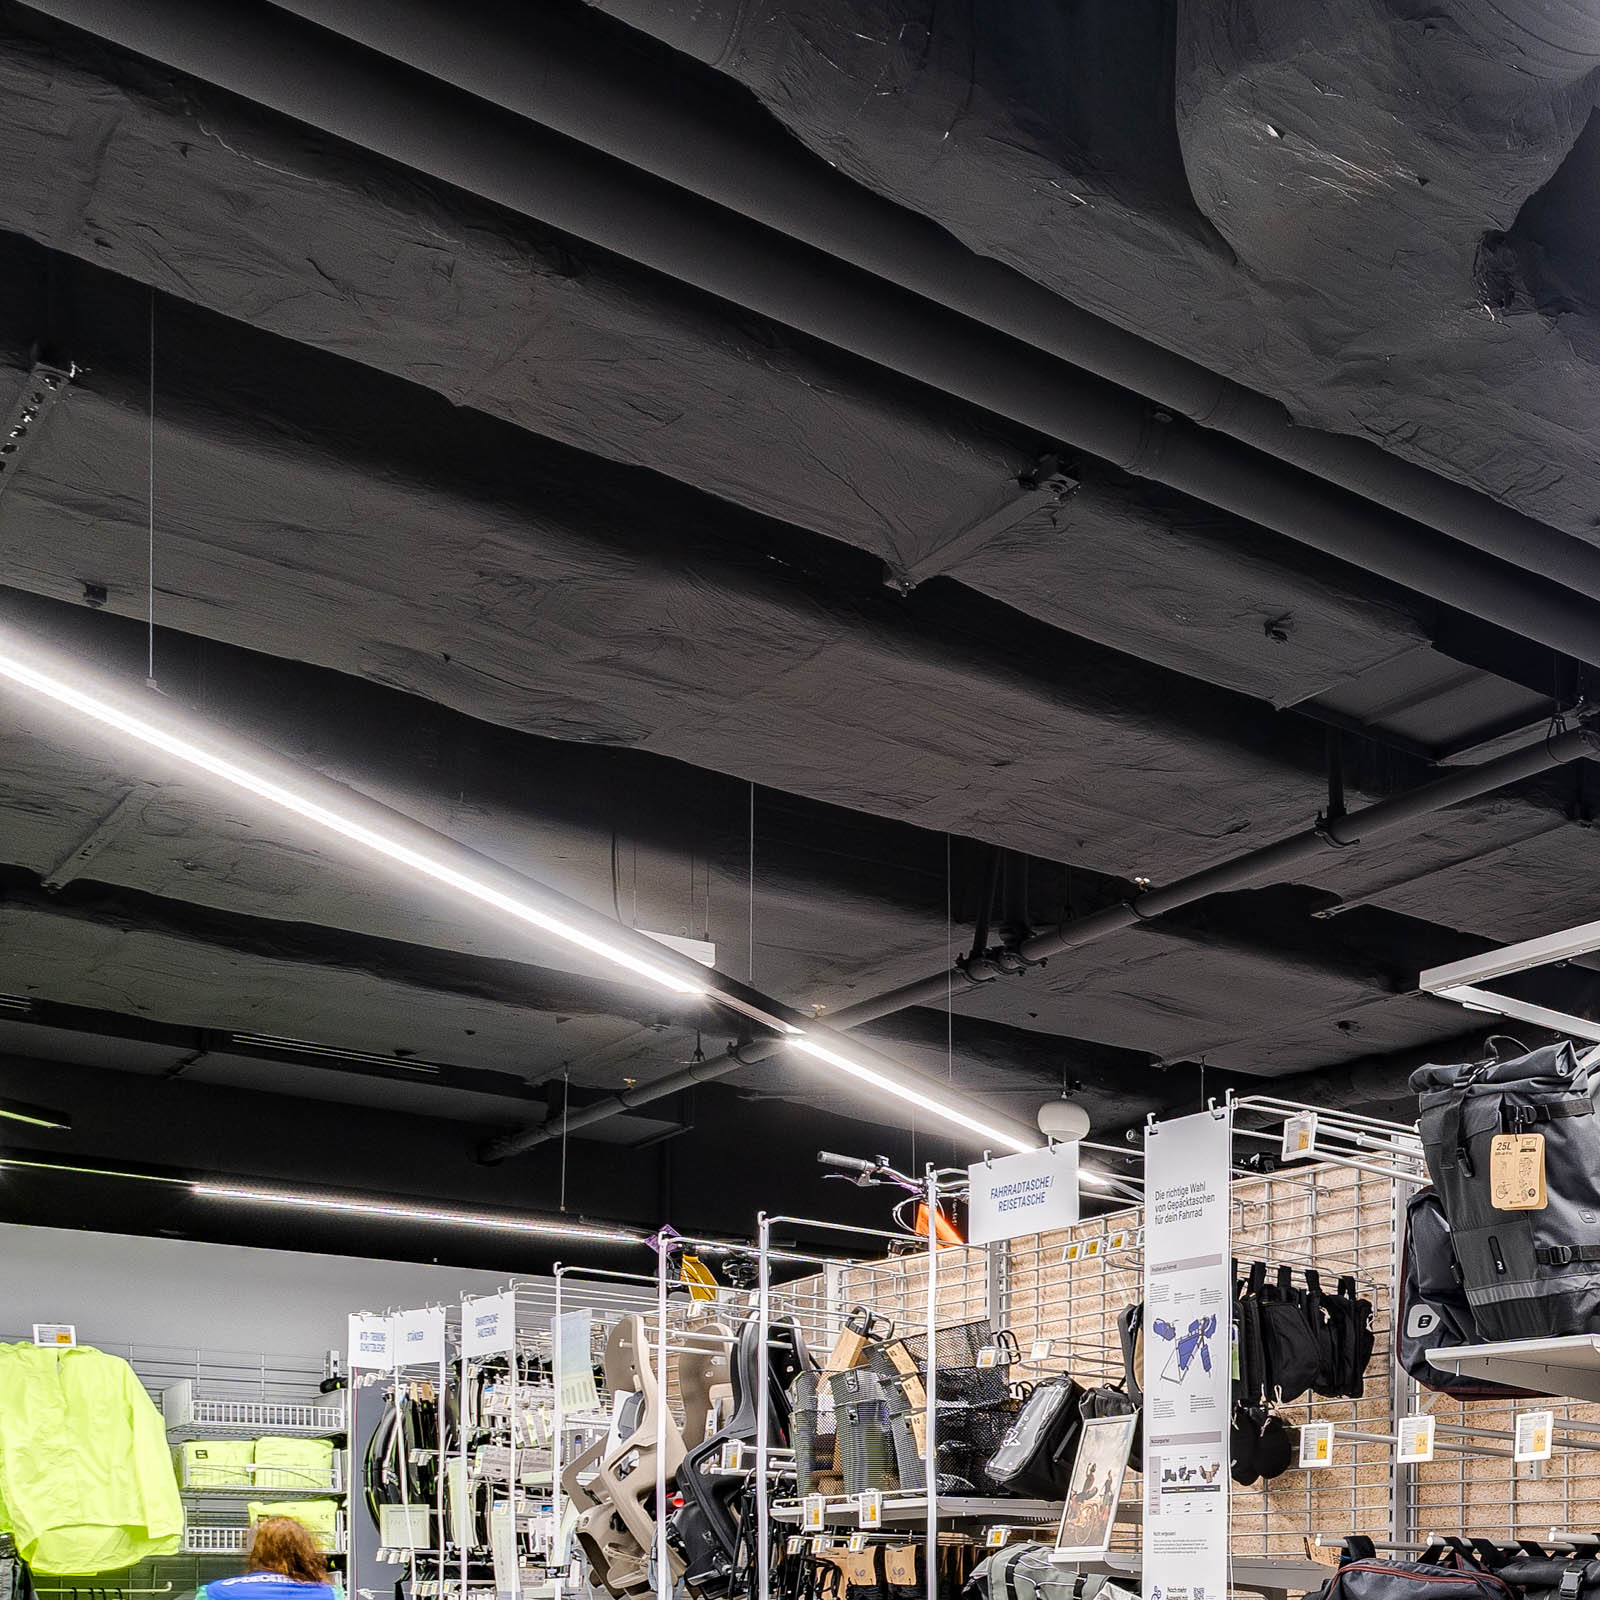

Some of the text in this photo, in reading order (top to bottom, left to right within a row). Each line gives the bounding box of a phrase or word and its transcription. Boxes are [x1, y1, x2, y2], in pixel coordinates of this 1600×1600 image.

[1496, 1141, 1512, 1151] 25L
[1154, 1181, 1206, 1201] Die richtige Wahl
[998, 1192, 1046, 1212] REISETASCHE
[1154, 1193, 1215, 1213] von Gepäcktaschen
[1165, 1211, 1177, 1223] dein
[1178, 1207, 1203, 1220] Fahrrad
